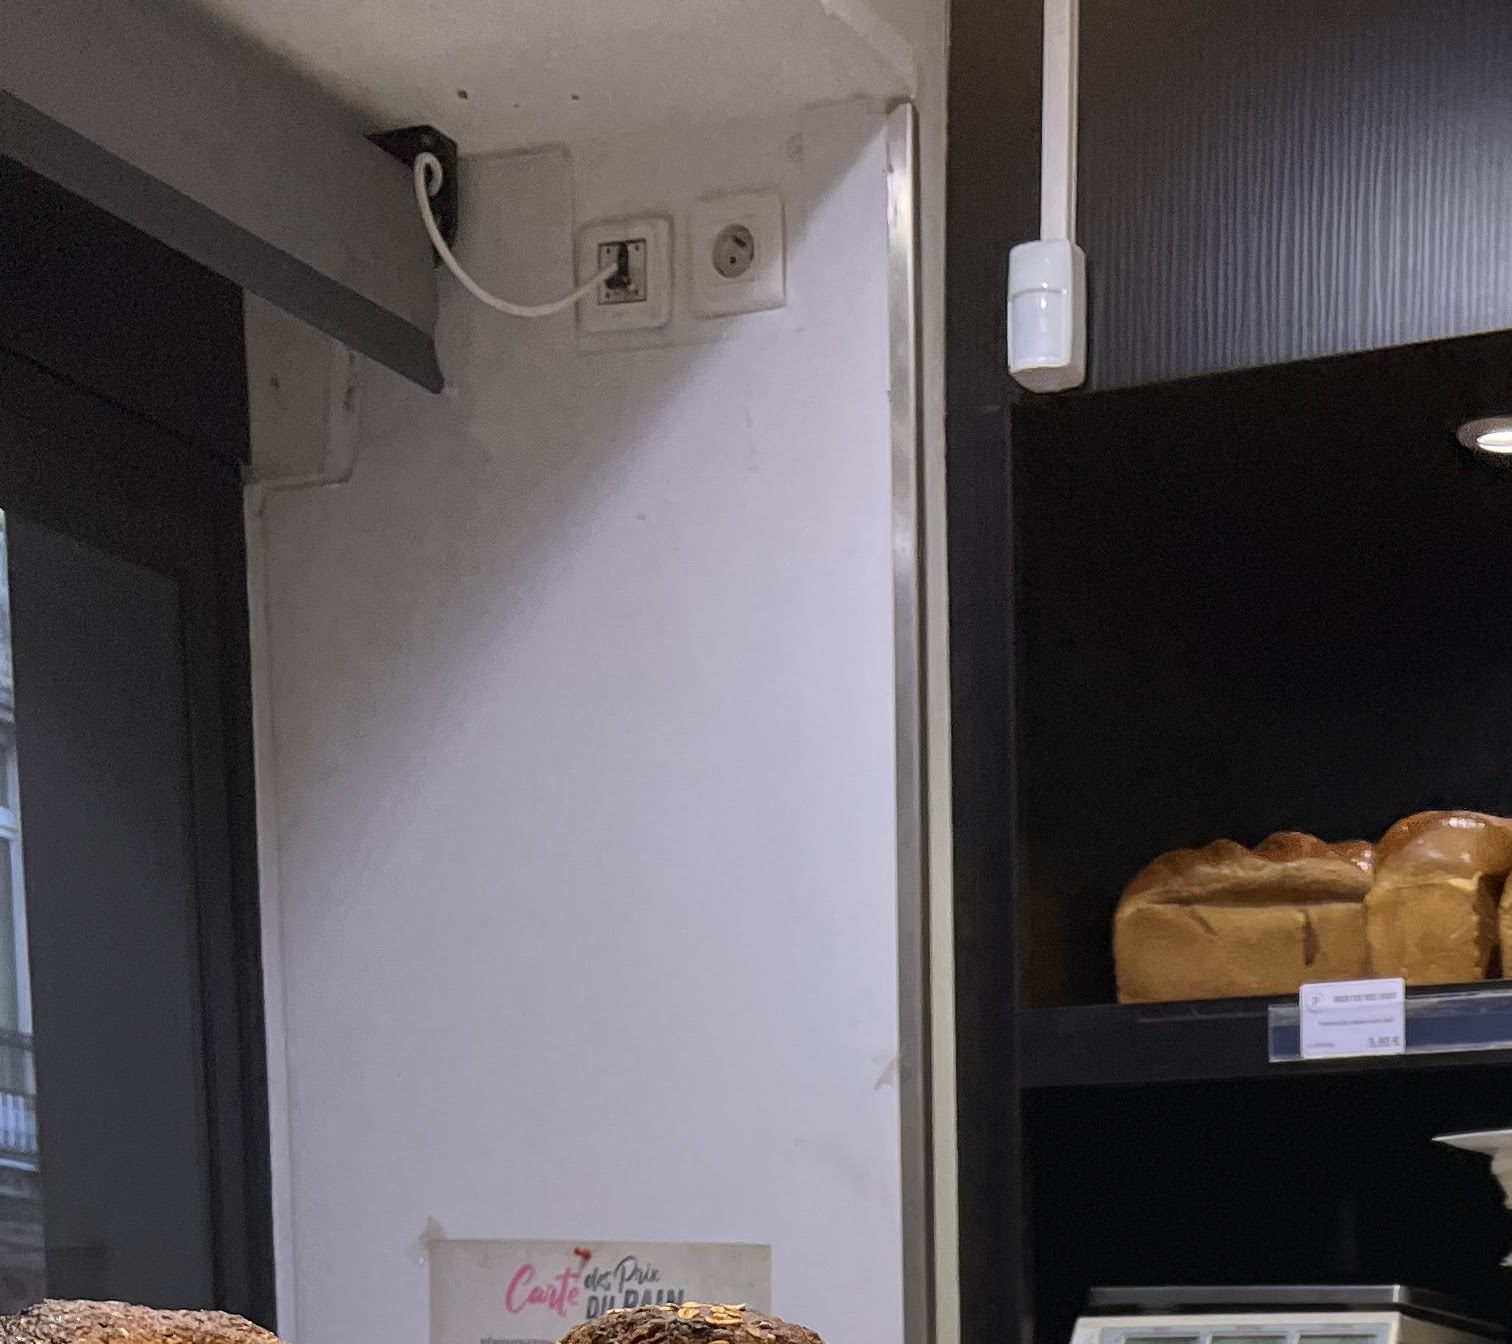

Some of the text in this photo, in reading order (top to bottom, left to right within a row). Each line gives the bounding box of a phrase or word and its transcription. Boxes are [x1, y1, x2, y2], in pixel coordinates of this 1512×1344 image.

[505, 1263, 580, 1317] Carte
[586, 1289, 685, 1319] DU PAIN
